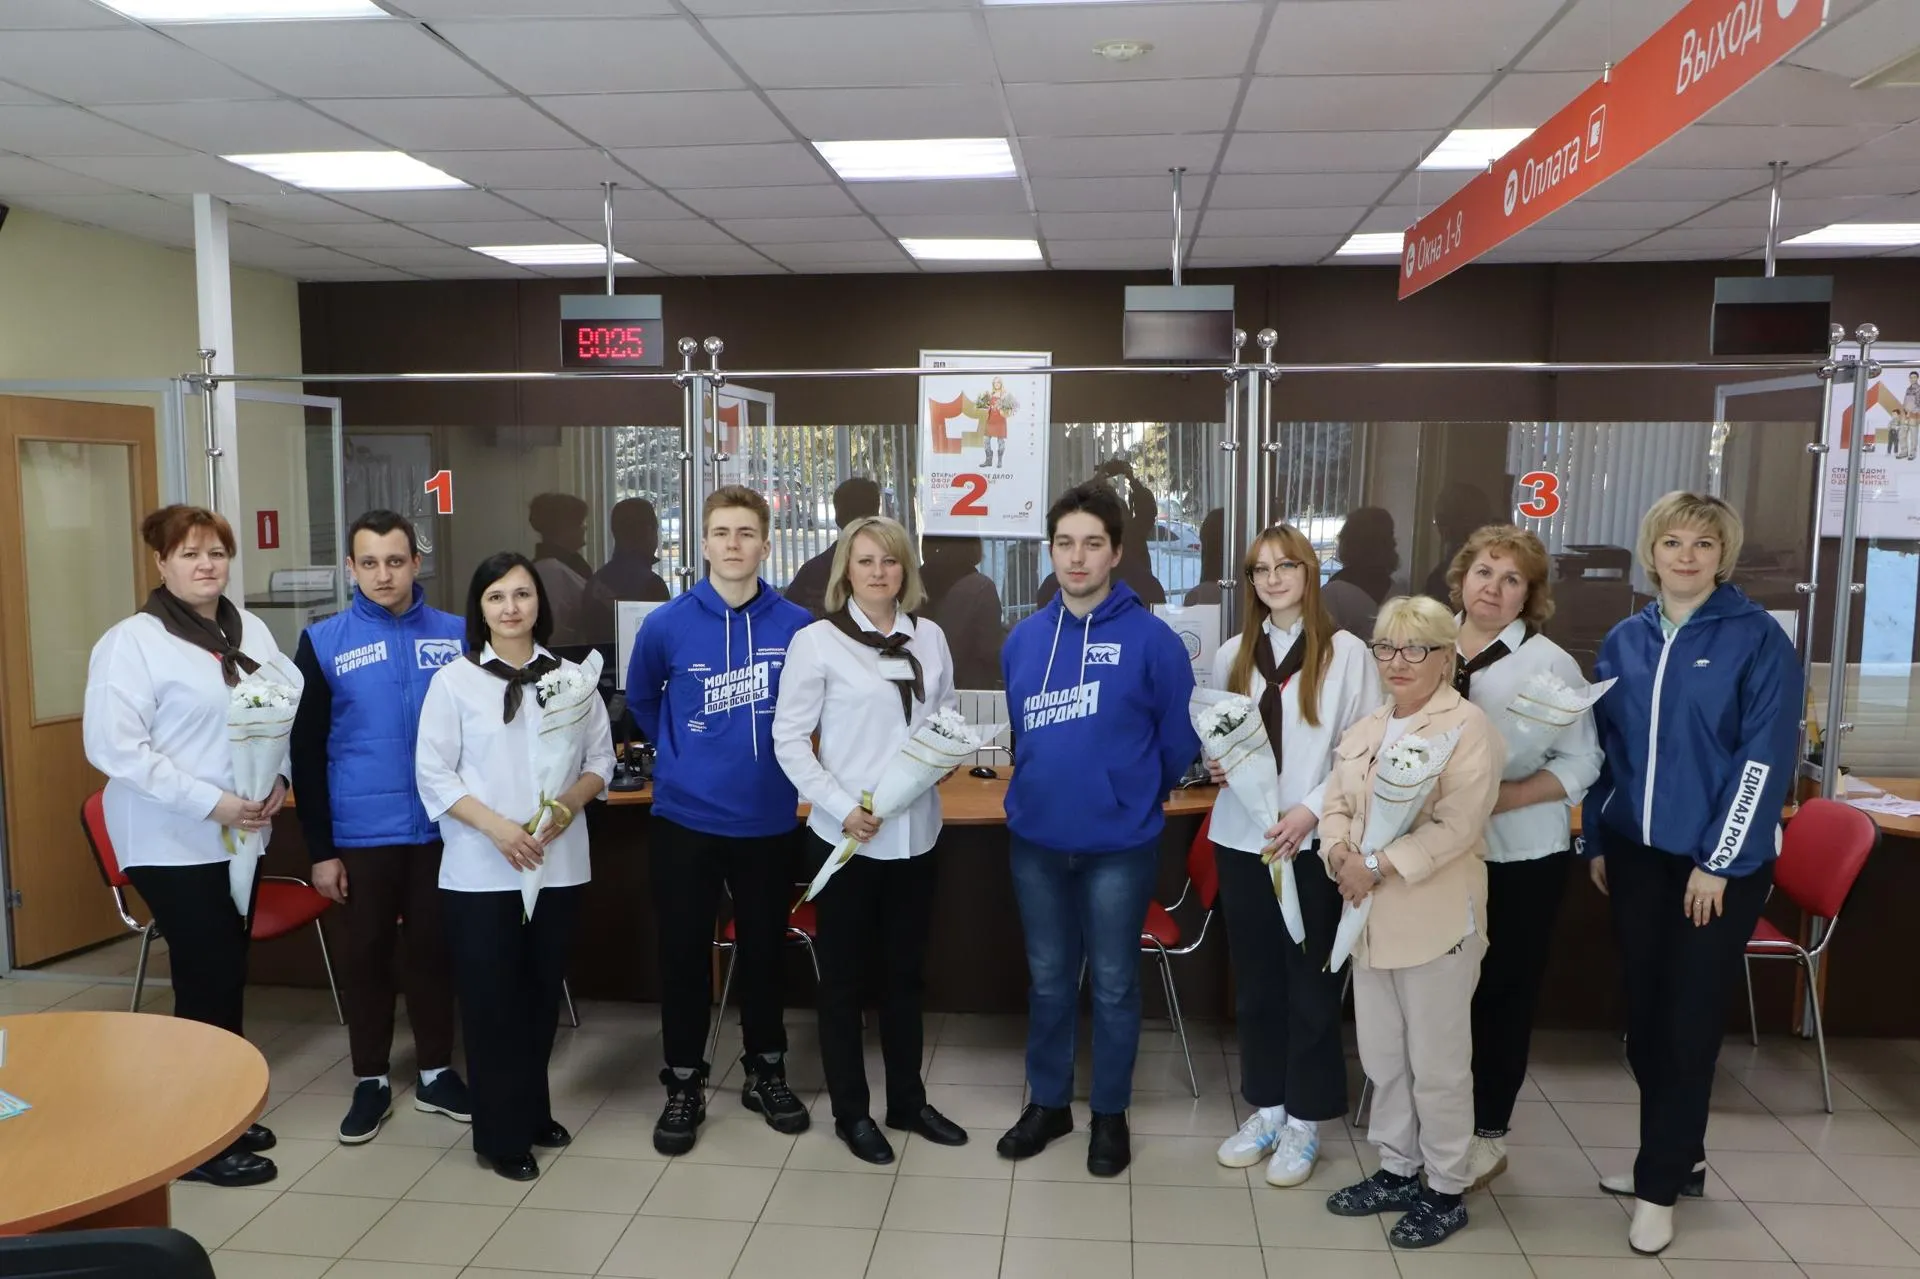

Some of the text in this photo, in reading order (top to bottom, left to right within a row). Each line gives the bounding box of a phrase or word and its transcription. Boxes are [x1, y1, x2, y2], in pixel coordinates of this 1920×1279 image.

[1676, 0, 1763, 95] Выход
[1522, 136, 1581, 204] Оплата
[1417, 210, 1462, 271] Окна 1-8
[424, 470, 453, 514] 1
[948, 472, 989, 517] 2
[1517, 471, 1560, 518] 3
[1731, 766, 1763, 825] ЕДИНАЯ
